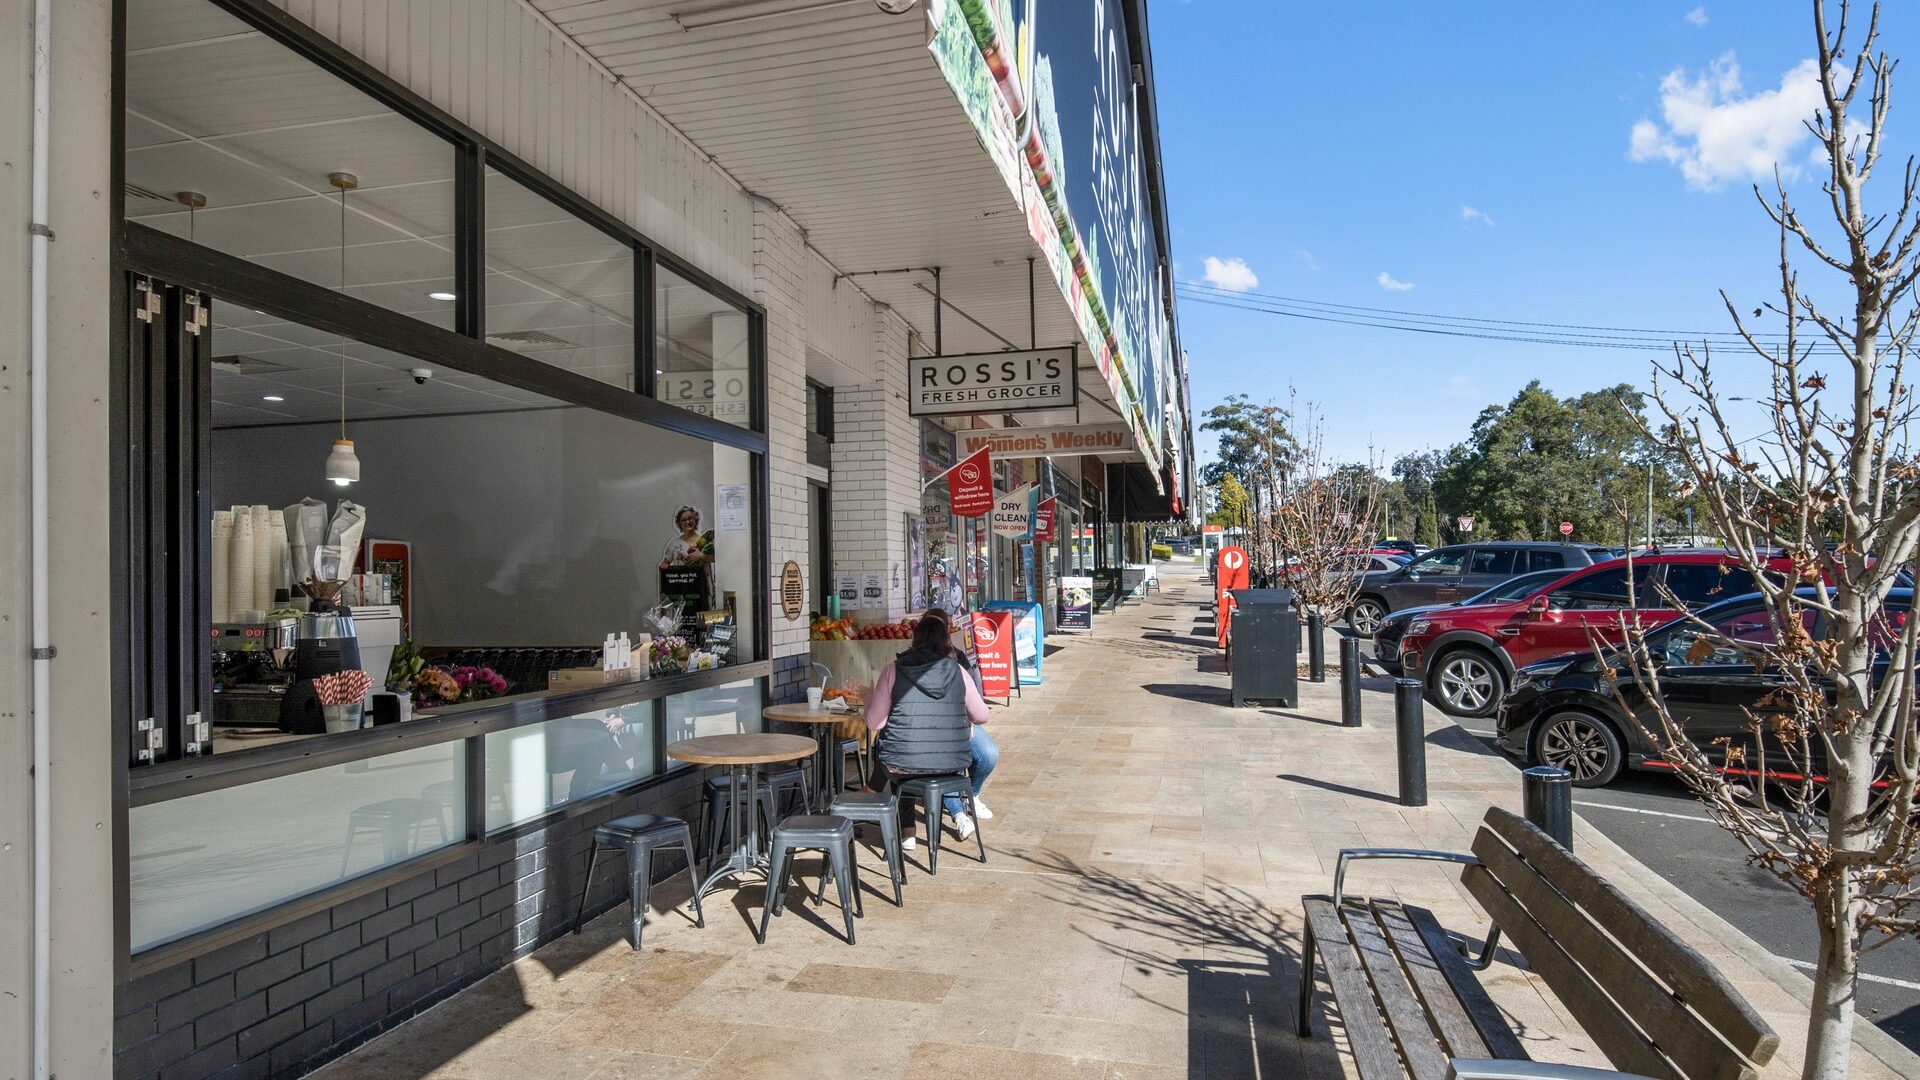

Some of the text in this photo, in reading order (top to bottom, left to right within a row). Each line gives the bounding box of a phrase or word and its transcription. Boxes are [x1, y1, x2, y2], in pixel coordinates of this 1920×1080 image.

[921, 358, 1061, 388] ROSSI'S
[921, 384, 1062, 403] FRESH GROCER
[965, 430, 1124, 453] Women's Weekly
[958, 485, 978, 493] Deposit
[954, 493, 978, 501] withdraw
[1001, 502, 1022, 511] DRY
[994, 513, 1027, 522] CLEAN
[994, 651, 1001, 659] &
[991, 661, 1008, 669] here
